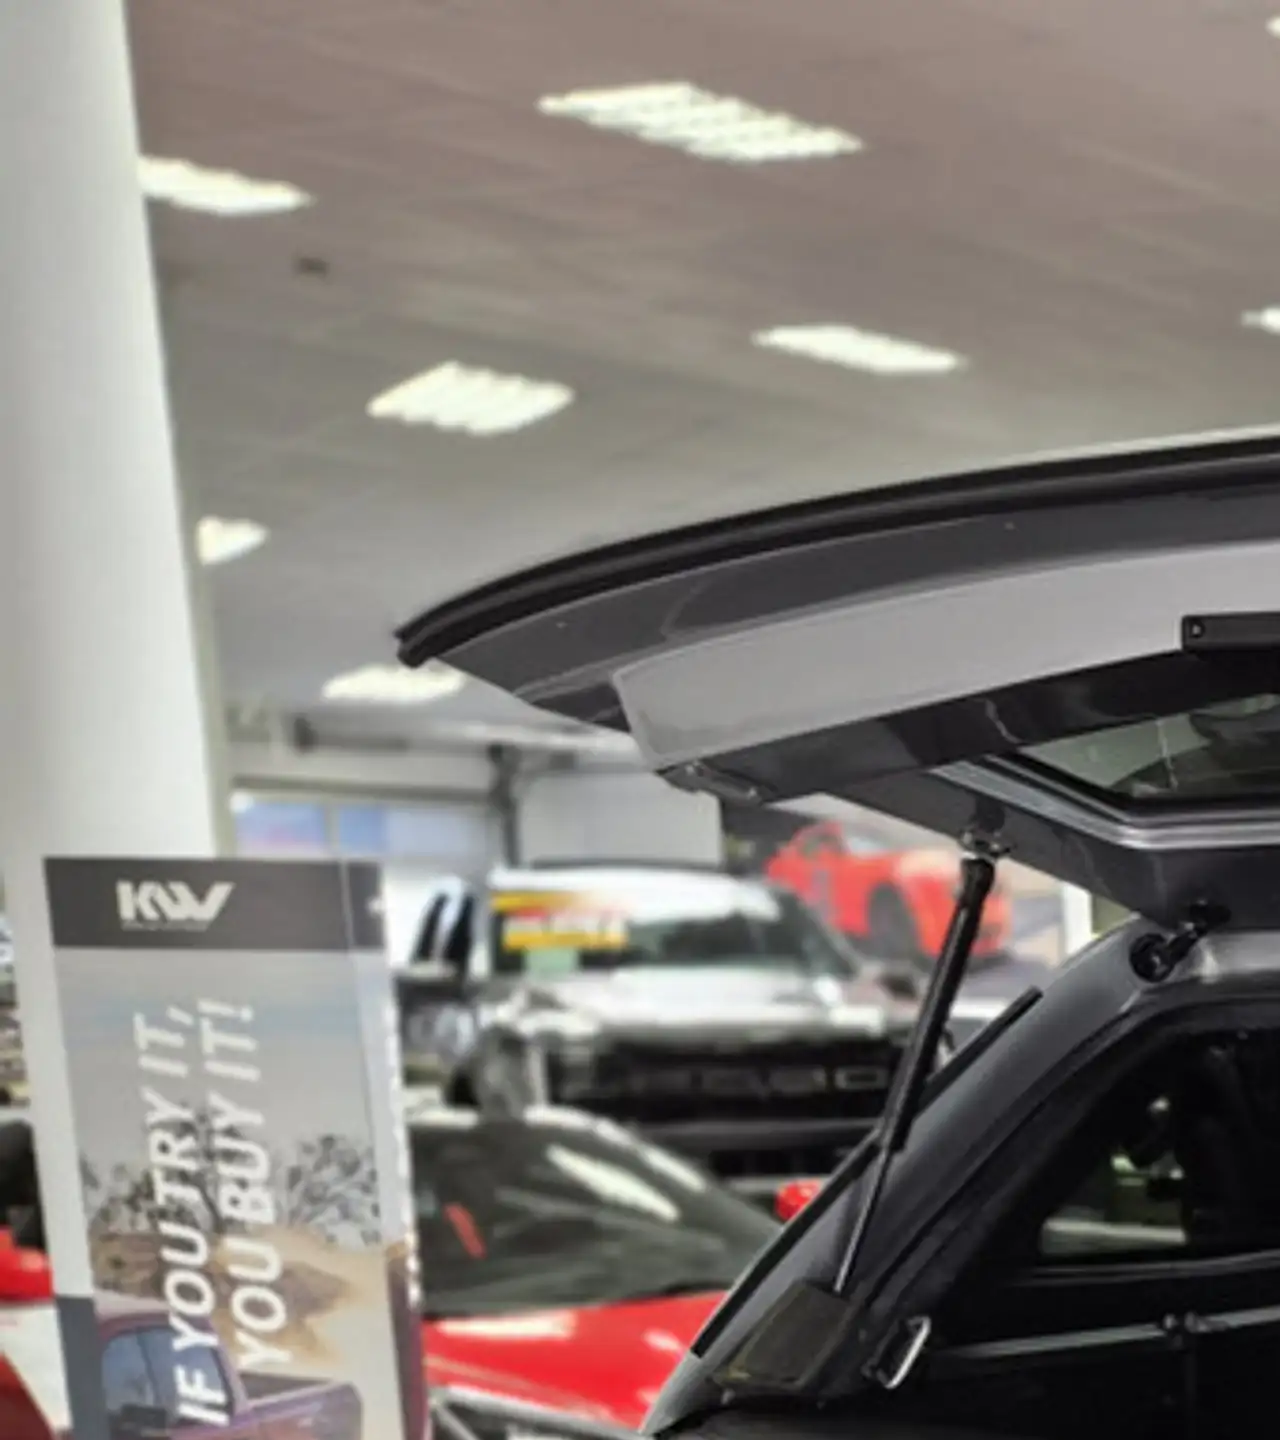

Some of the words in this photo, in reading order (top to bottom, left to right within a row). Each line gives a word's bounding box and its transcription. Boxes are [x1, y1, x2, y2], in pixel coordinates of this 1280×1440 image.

[116, 880, 236, 921] KW
[133, 1005, 194, 1079] IT,
[197, 997, 261, 1082] IT!
[141, 1086, 200, 1206] TRY
[208, 1090, 275, 1225] BUY
[157, 1220, 218, 1351] YOU
[223, 1235, 291, 1370] YOU
[173, 1363, 230, 1428] IF
